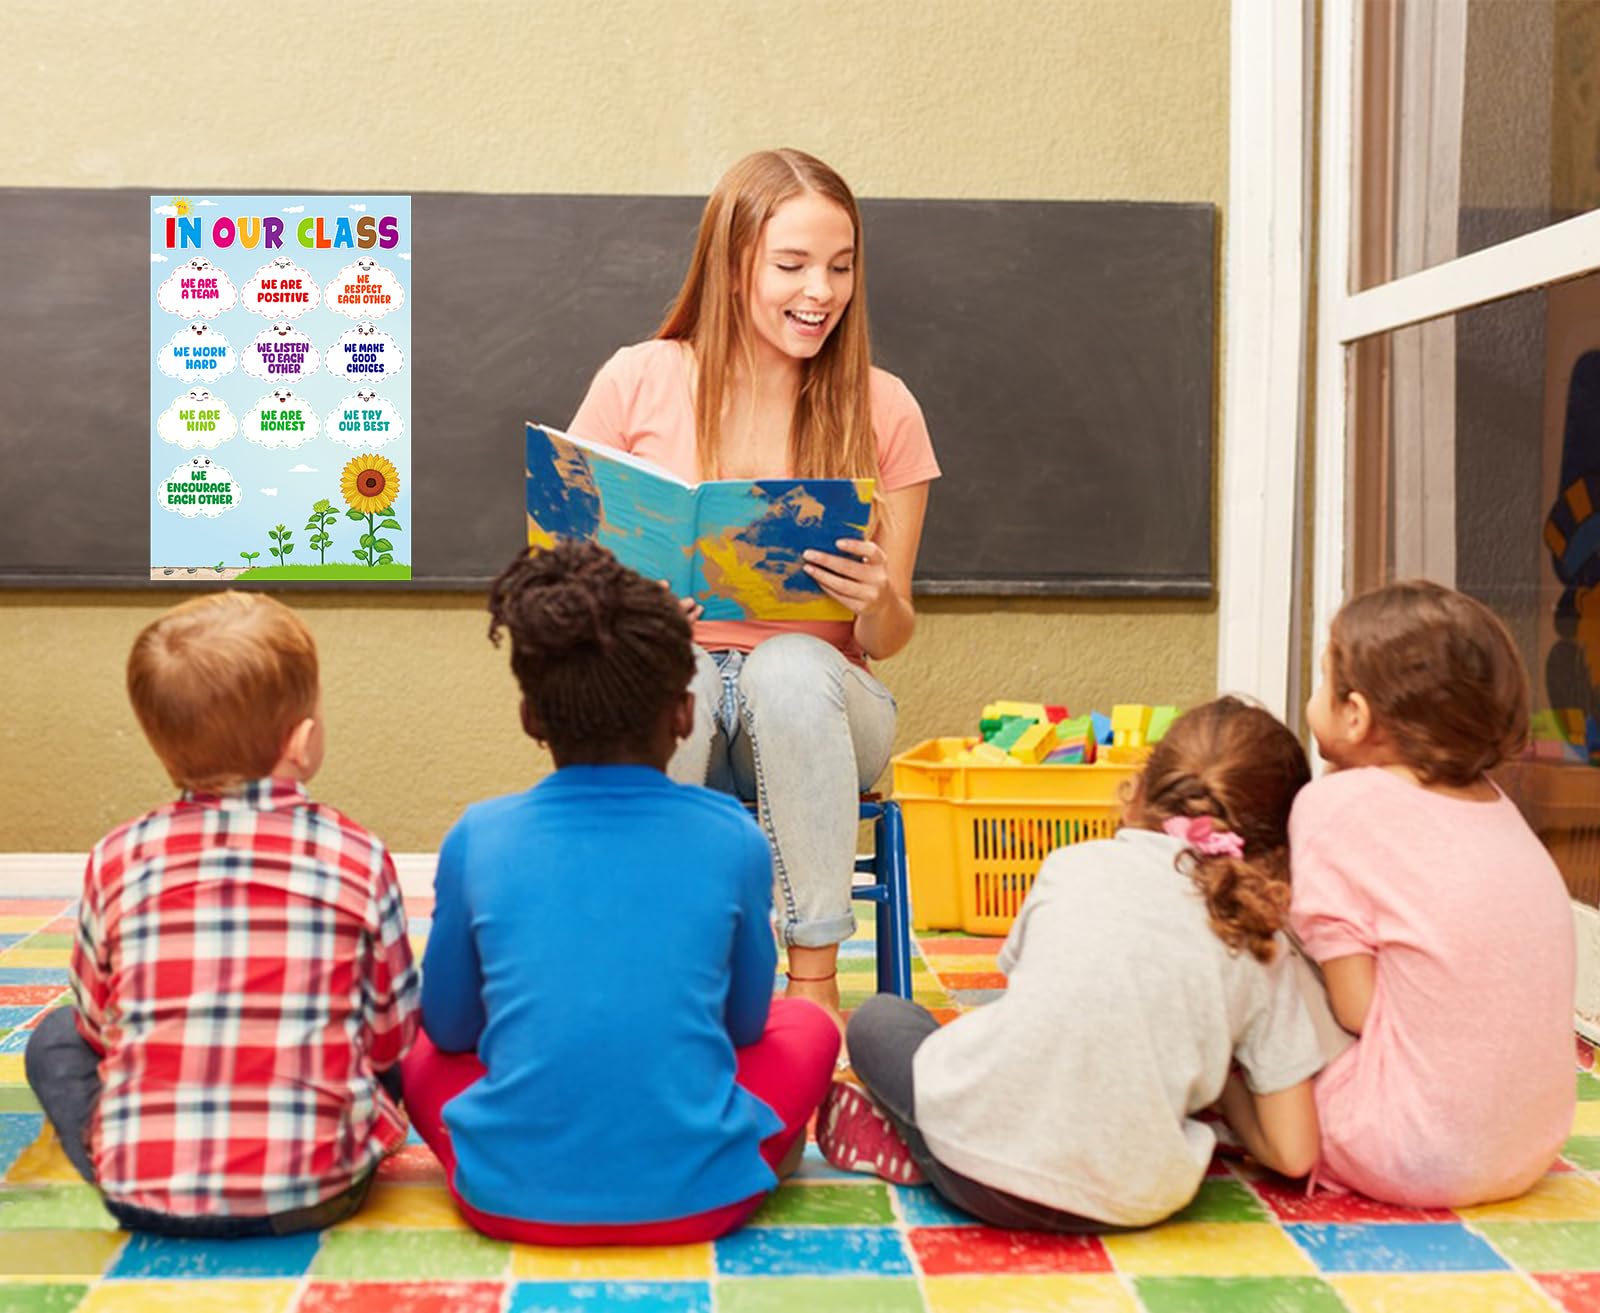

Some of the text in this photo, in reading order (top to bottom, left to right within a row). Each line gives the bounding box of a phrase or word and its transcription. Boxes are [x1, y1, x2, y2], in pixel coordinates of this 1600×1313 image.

[165, 216, 399, 249] IN OUR CLASS
[180, 279, 218, 289] WE ARE
[261, 279, 302, 290] WE ARE
[356, 275, 370, 284] WE
[181, 289, 219, 299] A TEAM
[344, 285, 383, 294] RESPECT
[257, 292, 309, 303] POSITIVE
[337, 295, 391, 304] EACH OTHER
[173, 347, 191, 357] WE
[257, 343, 310, 353] WE LISTEN
[344, 343, 357, 353] WE
[262, 353, 304, 363] TO EACH
[352, 354, 377, 363] GOOD
[185, 359, 217, 370] HARD
[268, 363, 301, 374] OTHER
[346, 364, 385, 373] CHOICES
[179, 410, 220, 420] WE ARE
[261, 410, 302, 420] WE ARE
[344, 410, 382, 420] WE TRY
[260, 421, 306, 431] HONEST
[338, 421, 390, 431] OUR BEST
[191, 471, 207, 481] WE
[167, 482, 231, 493] ENCOURAGE
[167, 494, 233, 505] EACH OTHER
